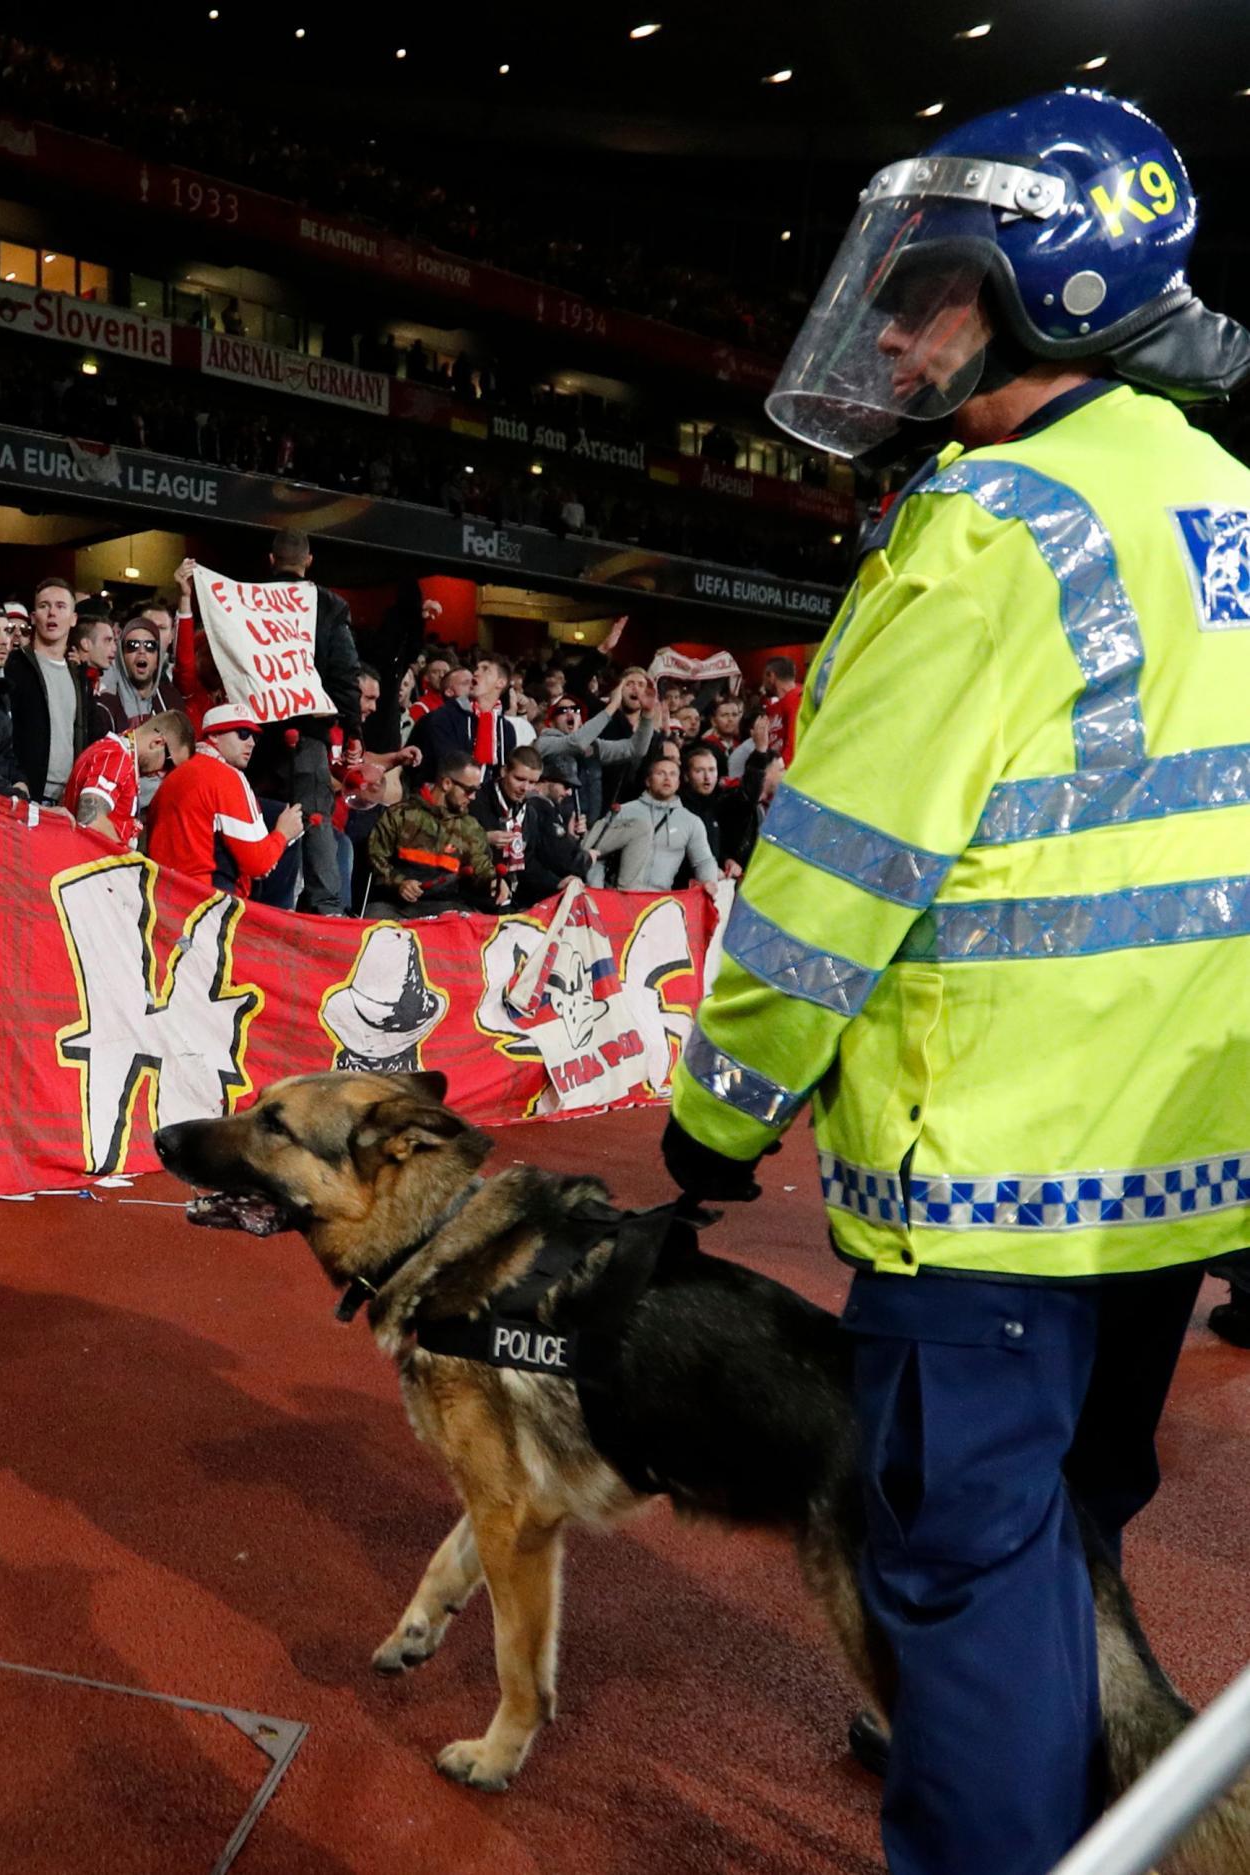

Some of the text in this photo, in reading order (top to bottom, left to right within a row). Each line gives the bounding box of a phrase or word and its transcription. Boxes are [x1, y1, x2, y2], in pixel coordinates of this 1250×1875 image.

[169, 177, 240, 226] 1933
[1090, 161, 1177, 238] K9
[417, 254, 471, 287] FOREVER
[34, 293, 167, 358] Slovenia
[558, 300, 608, 337] 1934
[206, 336, 283, 382] ARSENAL
[306, 361, 386, 407] GERMANY
[532, 425, 567, 452] san
[573, 428, 646, 471] Arsenal
[24, 448, 122, 488] EUROA
[129, 467, 218, 505] LEAGUE
[701, 463, 755, 498] Arsenal
[462, 525, 522, 563] FedEx
[695, 573, 832, 616] UEFA EUROPA LEAGUE
[252, 648, 315, 684] ULTR
[494, 1326, 569, 1368] POLICE
